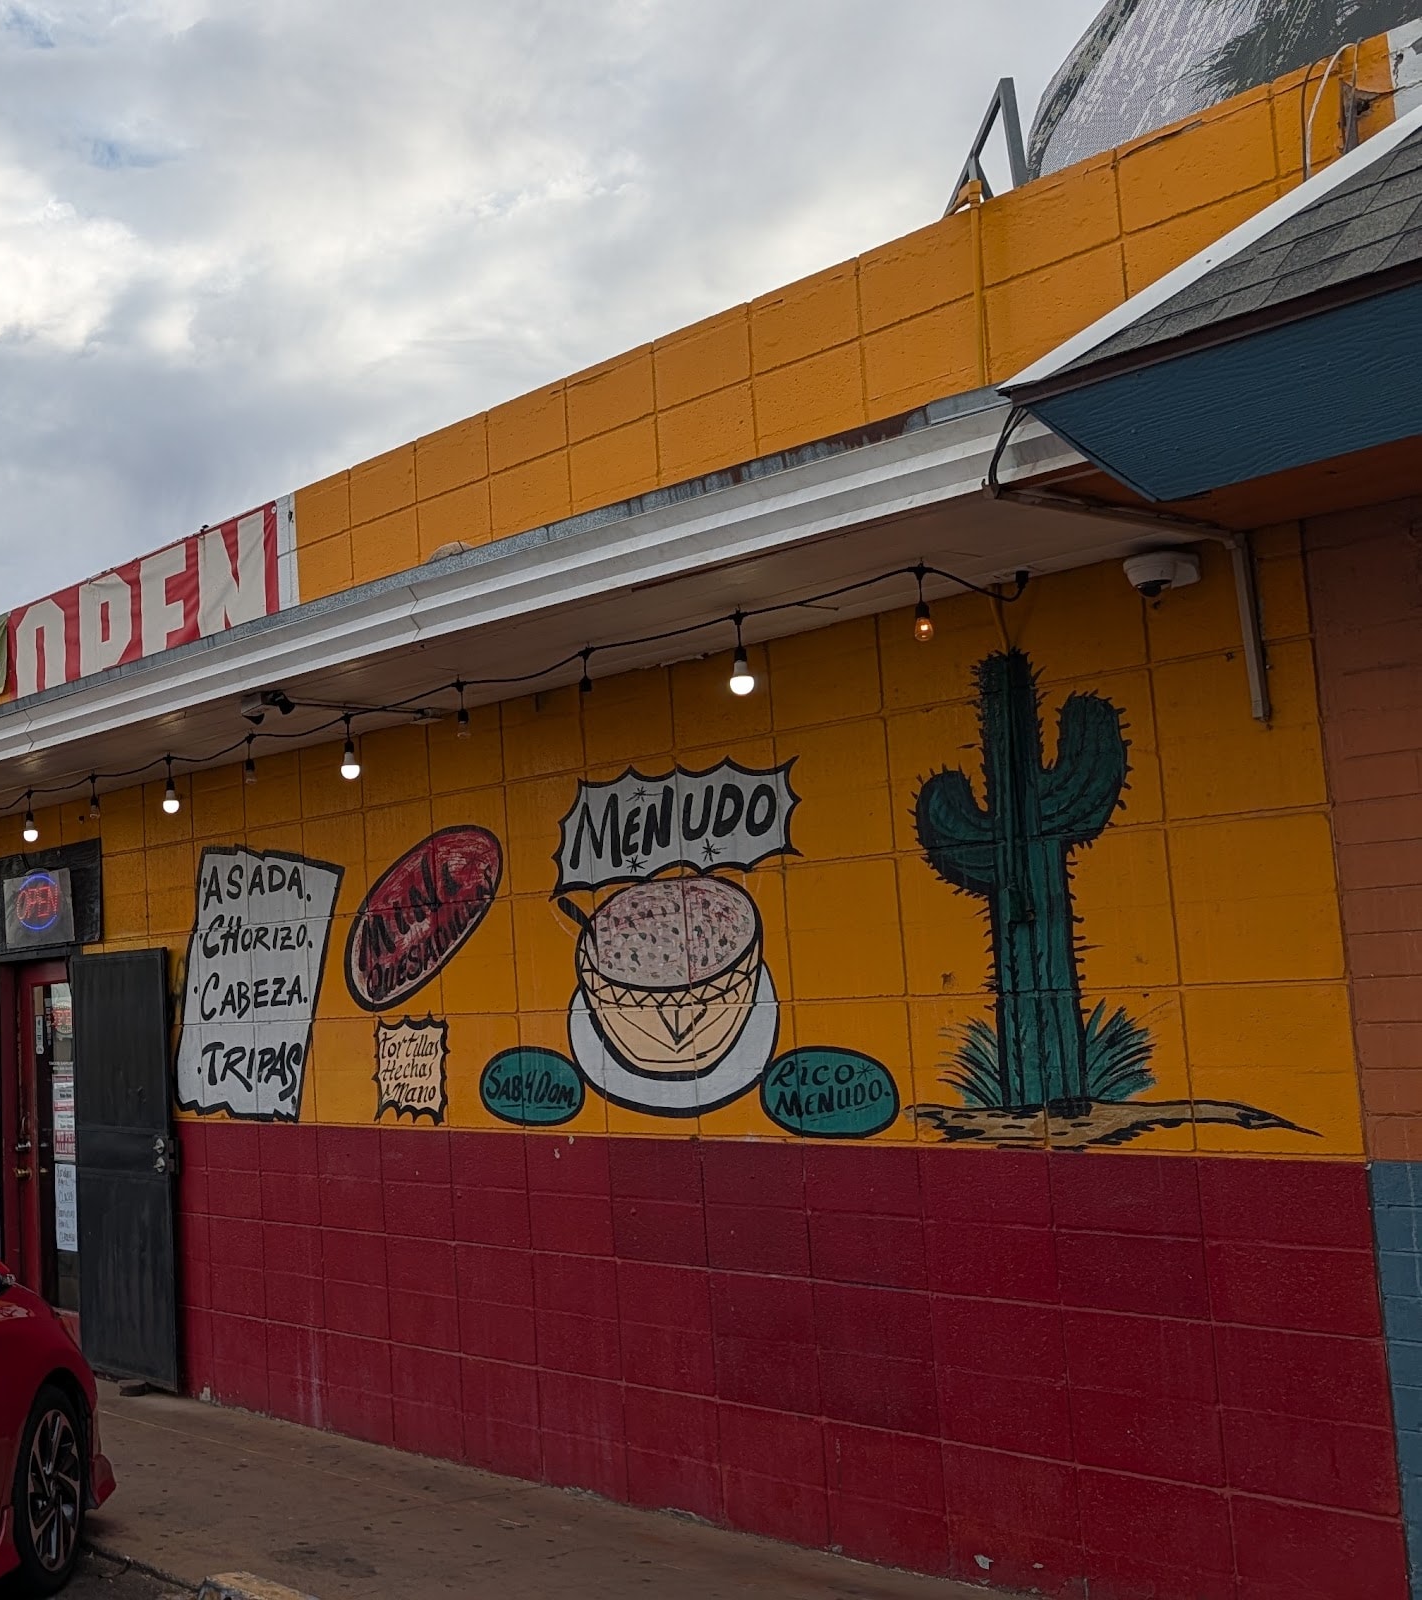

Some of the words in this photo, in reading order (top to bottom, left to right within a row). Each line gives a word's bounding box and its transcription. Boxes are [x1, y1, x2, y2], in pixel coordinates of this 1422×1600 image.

[16, 509, 268, 699] OPEN
[569, 783, 777, 870] MENUDO
[16, 883, 58, 920] OPEN
[382, 1059, 434, 1082] Hechas
[392, 1083, 437, 1104] Mano
